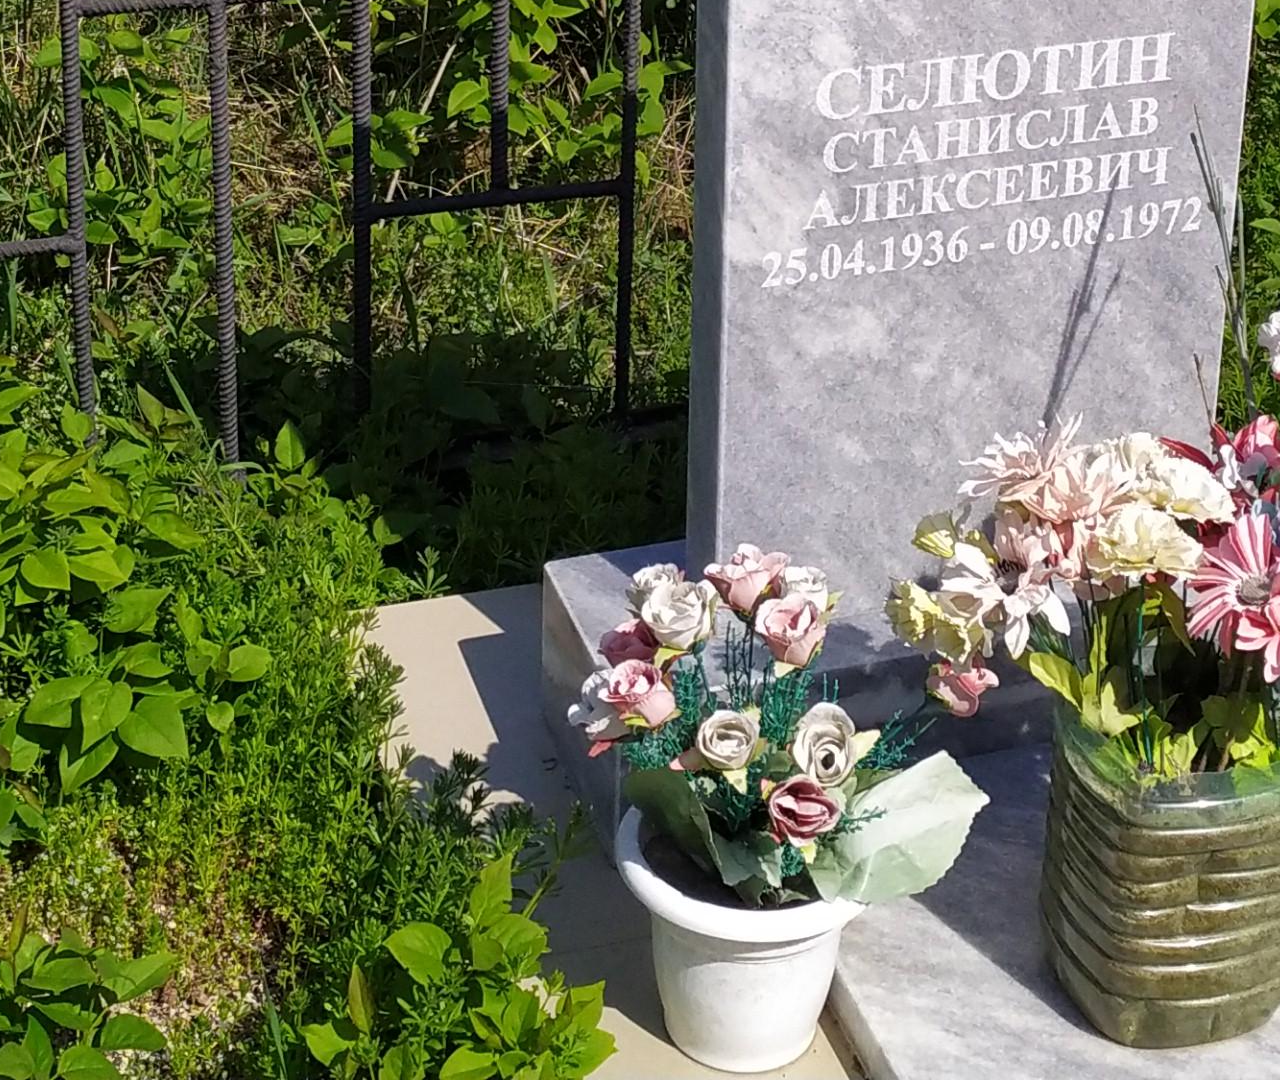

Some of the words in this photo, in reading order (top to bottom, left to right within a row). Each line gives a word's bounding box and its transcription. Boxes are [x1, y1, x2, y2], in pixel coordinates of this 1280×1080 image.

[817, 32, 1176, 120] СЕЛЮТИН
[823, 97, 1159, 173] СТАНИСЛАВ
[803, 147, 1173, 229] АЛЕКСЕЕВИЧ
[761, 226, 969, 289] 25.04.1936
[1006, 196, 1202, 255] 09.08.1972
